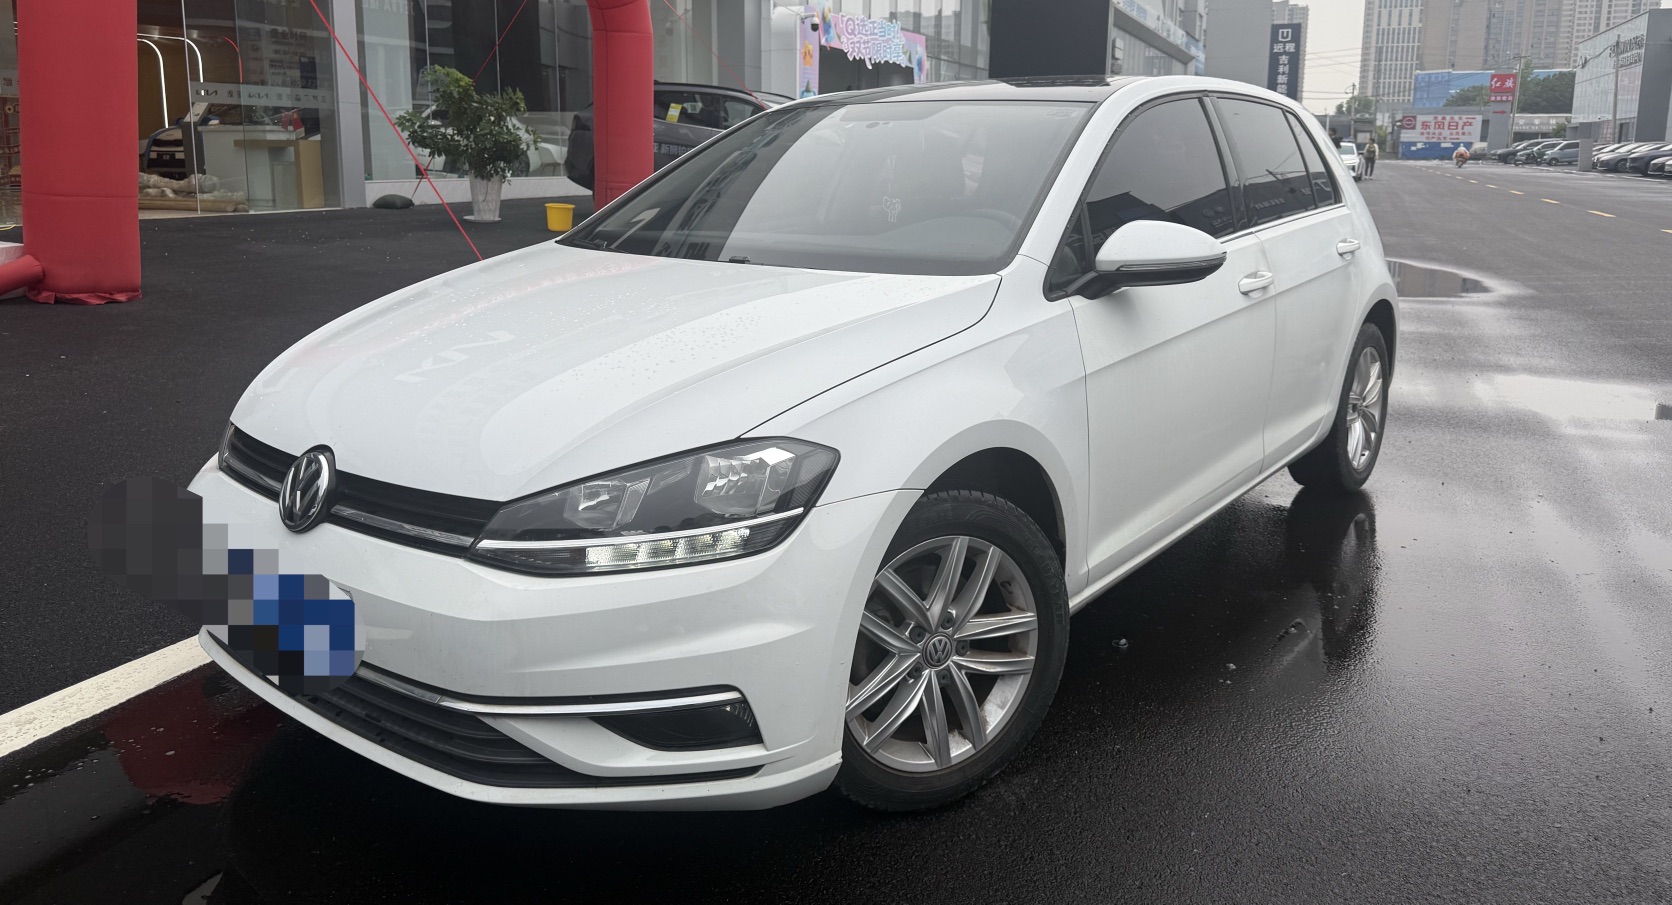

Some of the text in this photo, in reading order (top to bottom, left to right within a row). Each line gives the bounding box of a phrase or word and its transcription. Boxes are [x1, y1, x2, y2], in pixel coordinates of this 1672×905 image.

[1273, 43, 1296, 53] 远程
[1276, 55, 1290, 95] 吉利新能
[1491, 77, 1515, 89] 红旗
[1420, 121, 1473, 130] 东风日产
[660, 143, 692, 156] 新狮铂
